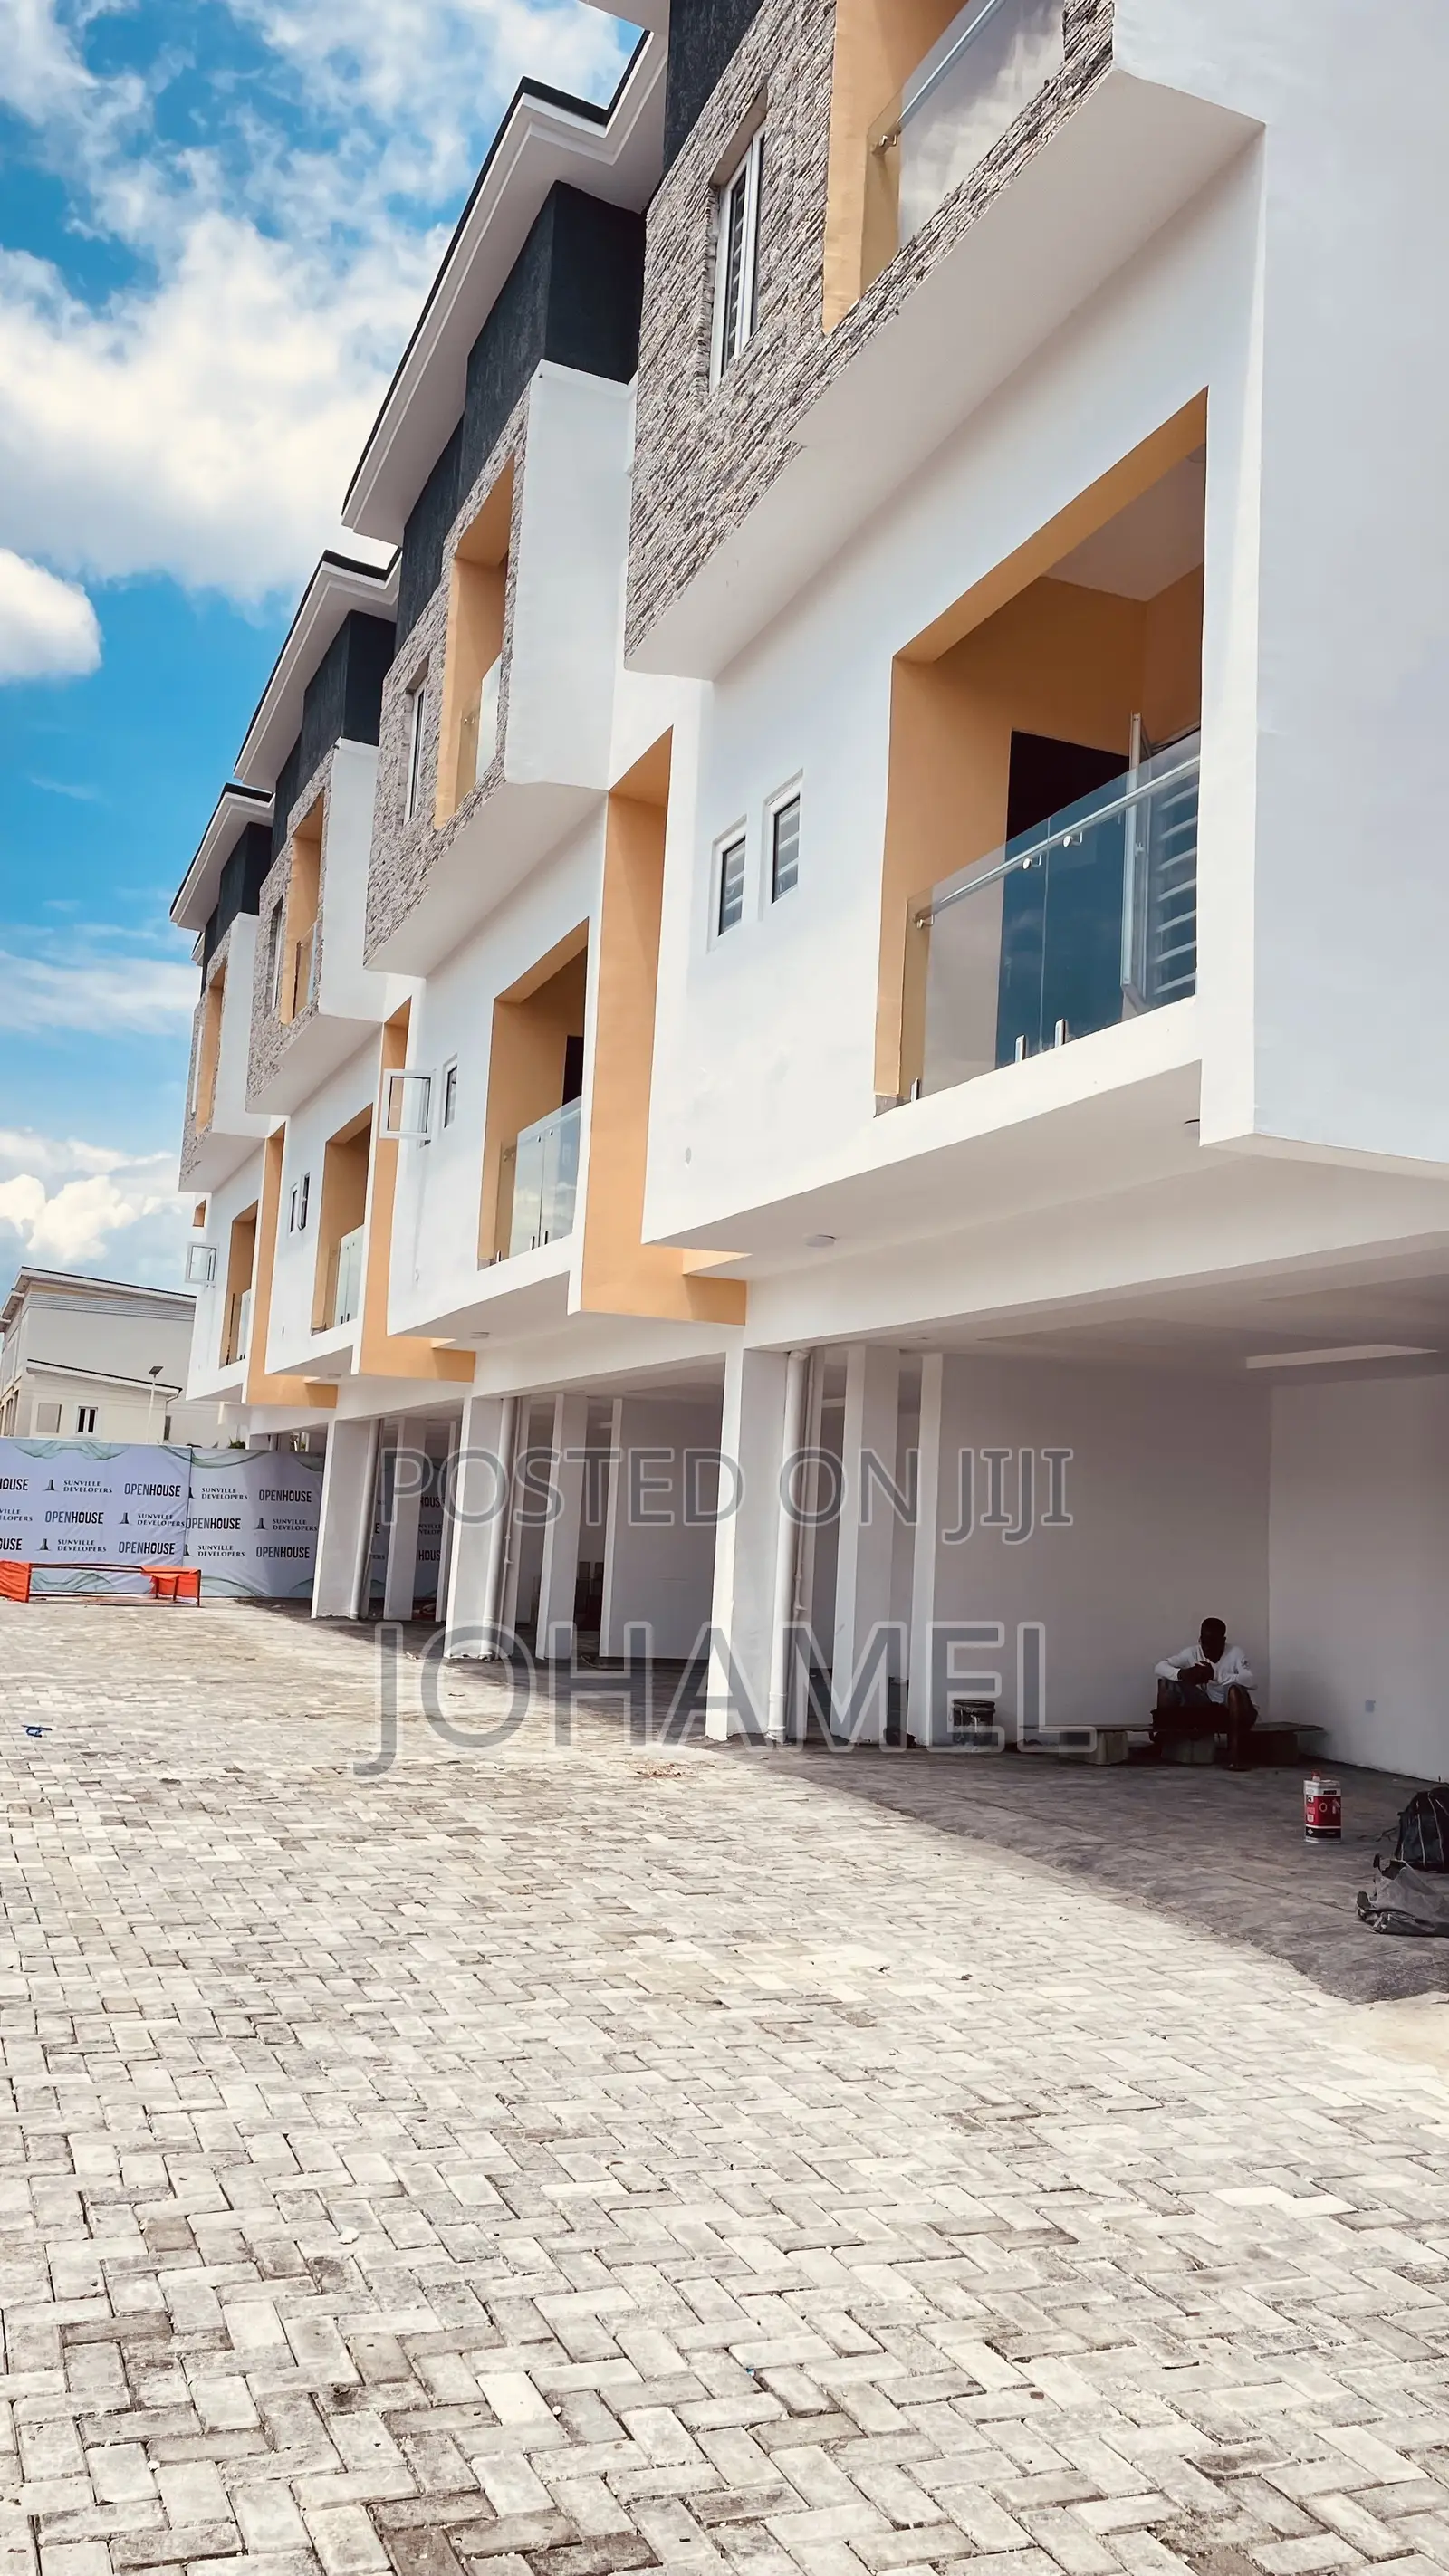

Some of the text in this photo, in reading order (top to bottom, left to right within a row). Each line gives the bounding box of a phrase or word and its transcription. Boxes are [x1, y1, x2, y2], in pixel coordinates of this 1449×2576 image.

[124, 1483, 181, 1497] OPENHOUSE
[259, 1489, 312, 1503] OPENHOUSE
[44, 1510, 104, 1524] OPENHOUSE
[186, 1518, 241, 1530] OPENHOUSE
[119, 1541, 176, 1555] OPENHOUSE
[256, 1546, 310, 1559] OPENHOUSE
